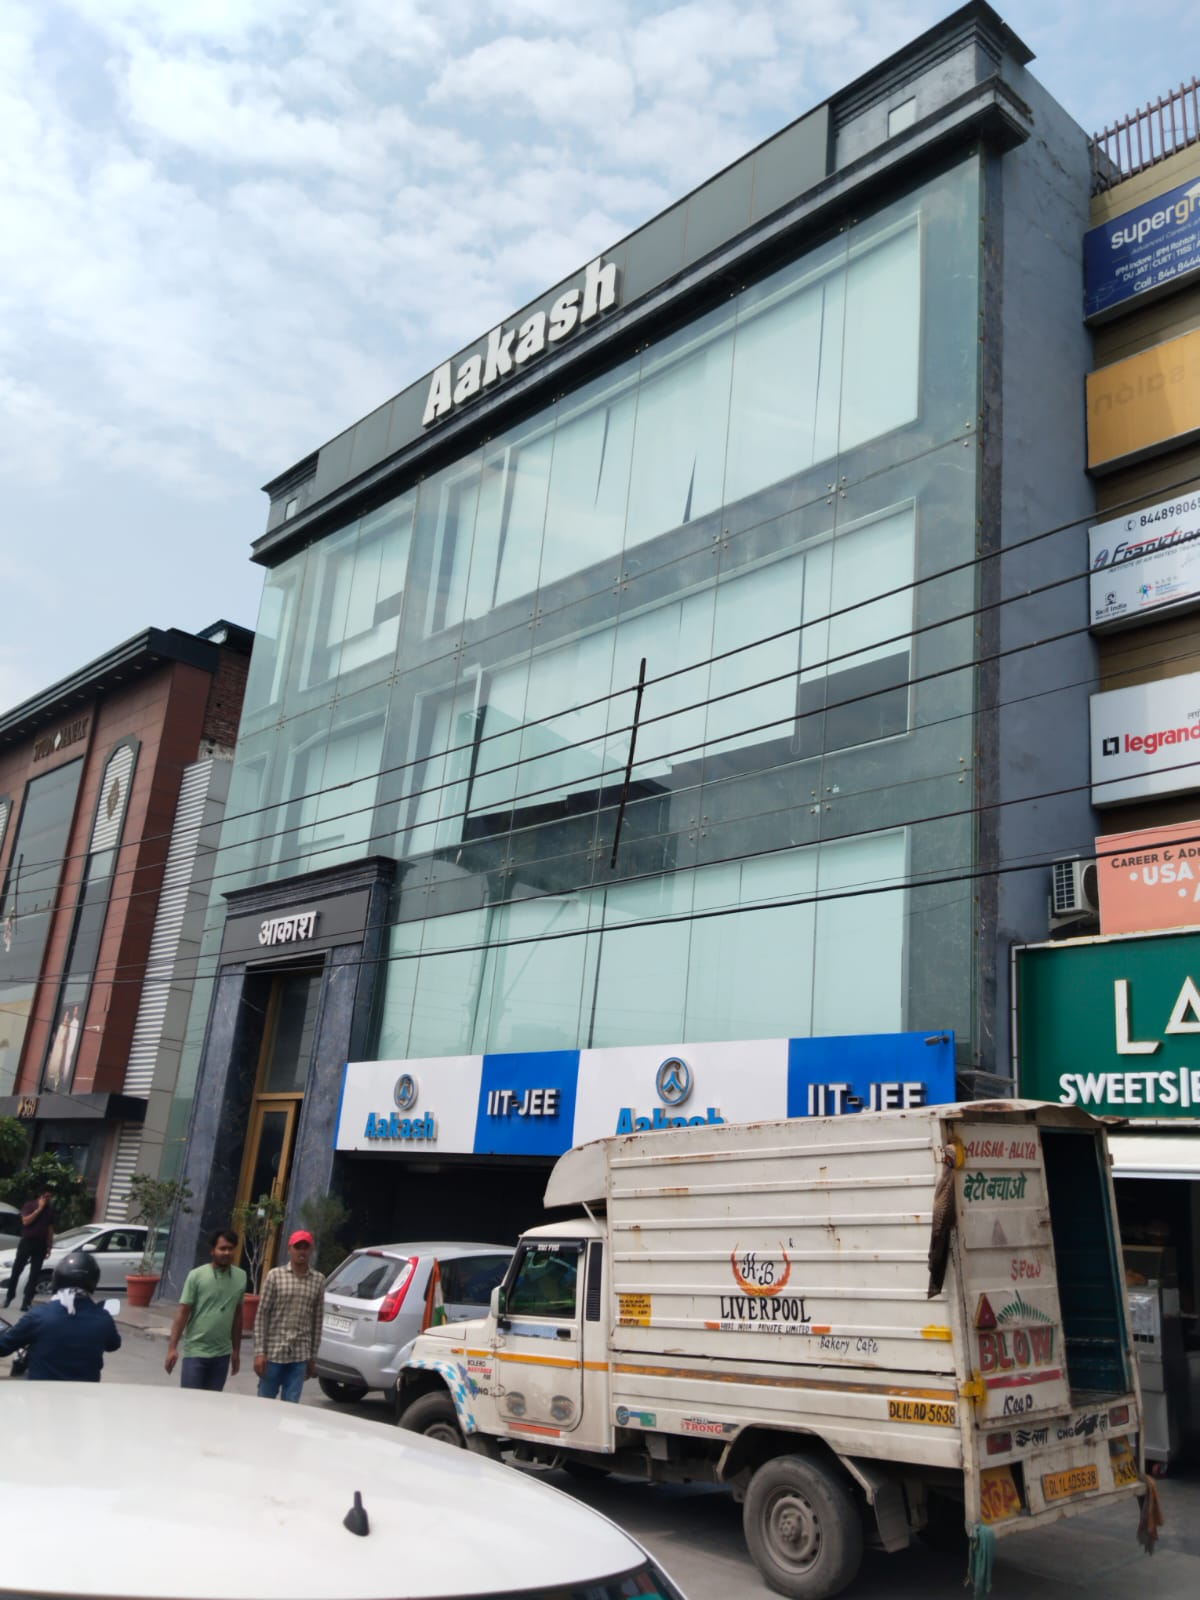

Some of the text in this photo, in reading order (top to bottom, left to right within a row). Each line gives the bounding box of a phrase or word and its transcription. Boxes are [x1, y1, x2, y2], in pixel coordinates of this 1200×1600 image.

[1111, 193, 1200, 250] supergr
[421, 257, 617, 427] Aakash
[1125, 719, 1200, 755] legrand
[1111, 854, 1159, 868] CAREER
[1163, 850, 1174, 861] &
[1142, 861, 1194, 886] USA
[258, 910, 317, 945] आकाश
[1114, 976, 1200, 1054] LA
[487, 1089, 558, 1116] IIT-JEE
[364, 1111, 436, 1139] Aakash
[720, 1295, 812, 1323] LIVERPOOL
[819, 1335, 850, 1353] Bakery
[978, 1326, 1054, 1373] BLOW
[1057, 1427, 1074, 1440] CNG
